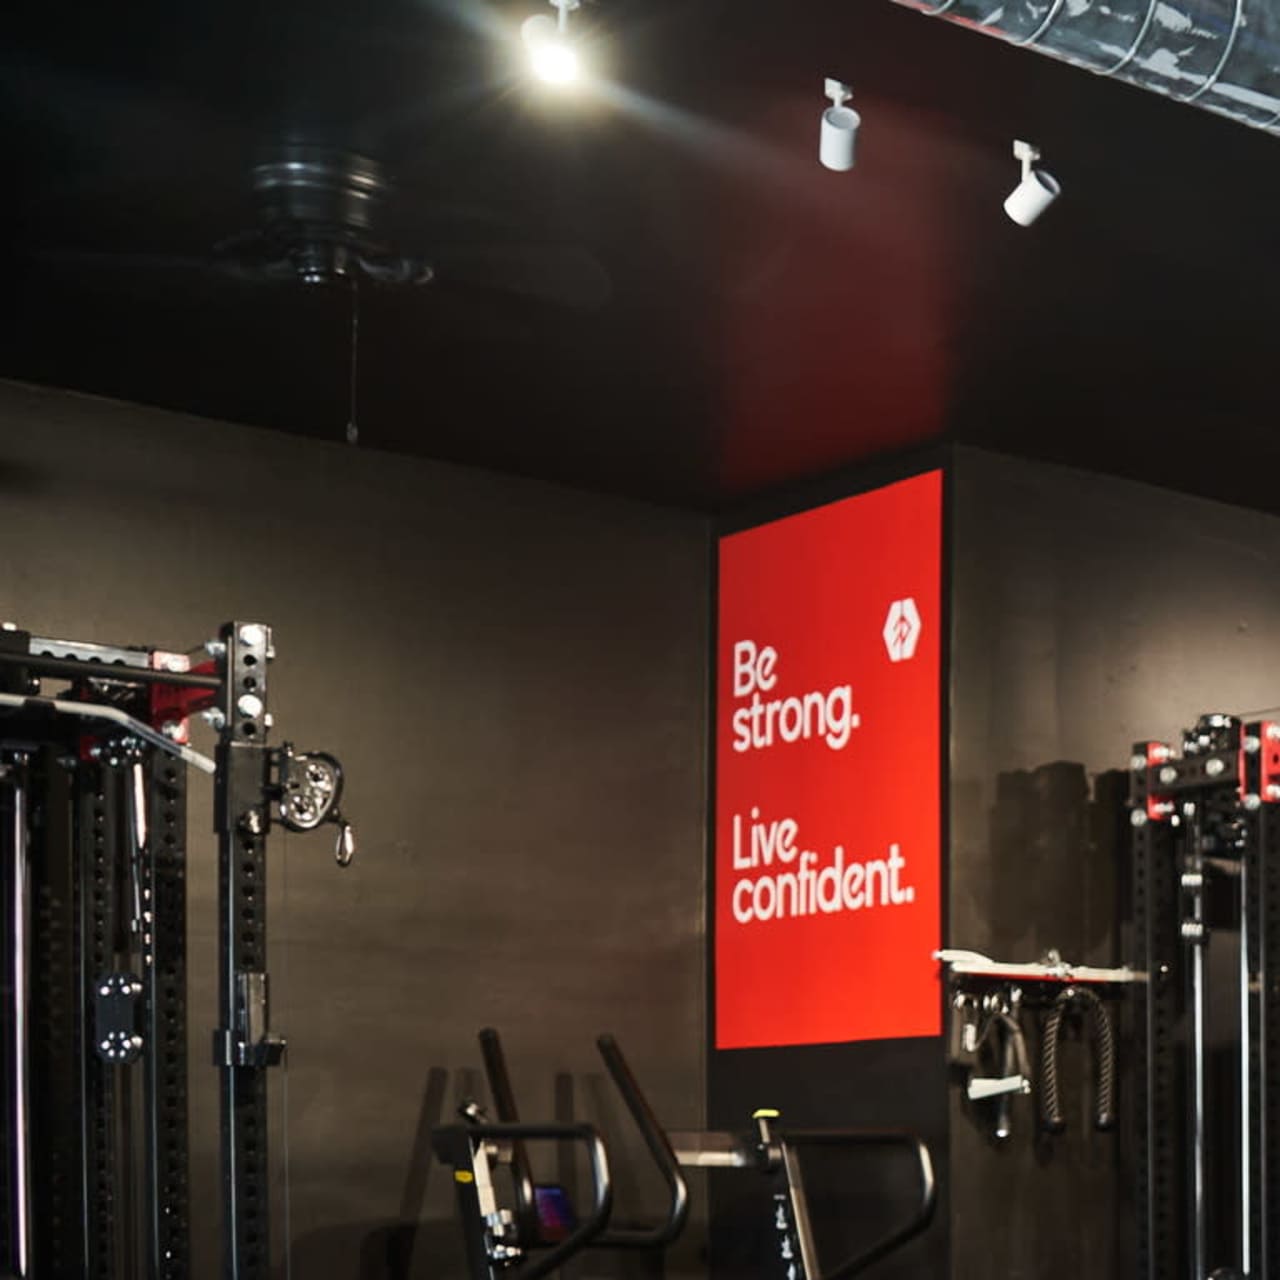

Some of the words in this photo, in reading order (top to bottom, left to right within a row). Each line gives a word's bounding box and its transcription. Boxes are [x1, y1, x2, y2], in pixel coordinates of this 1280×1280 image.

[733, 639, 778, 698] Be
[732, 684, 861, 752] strong.
[733, 806, 799, 870] Live
[732, 843, 915, 924] confident.
